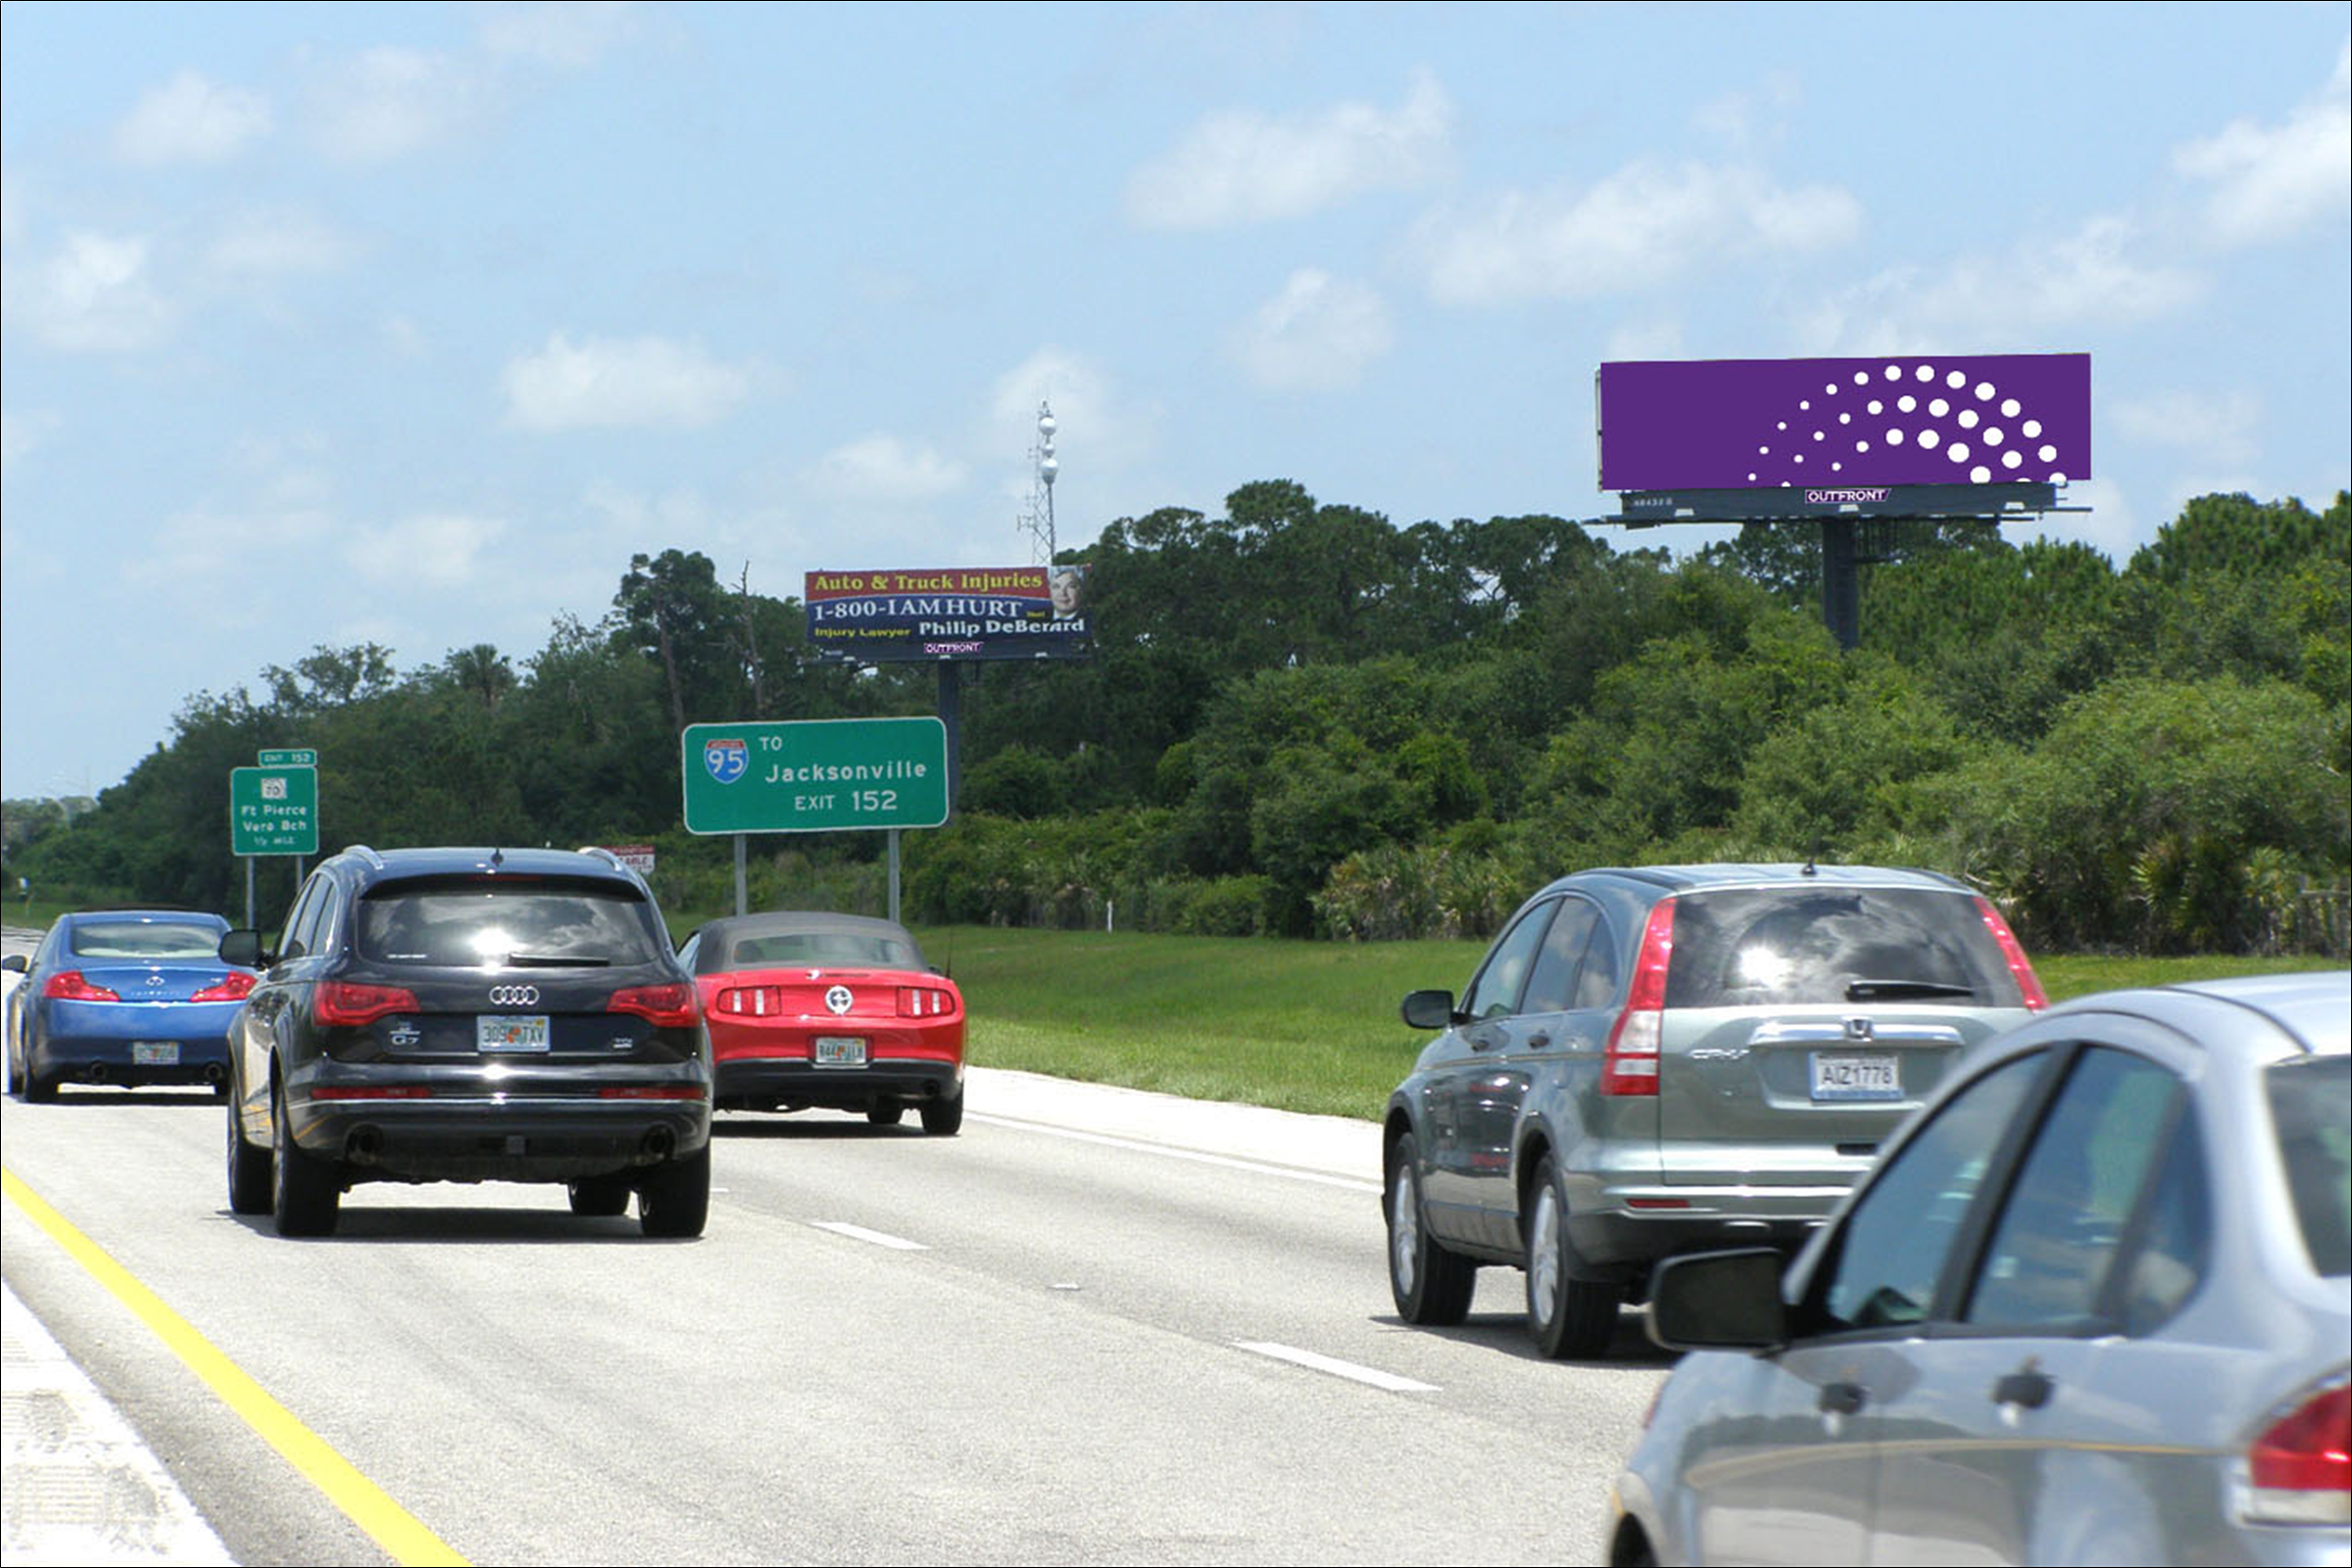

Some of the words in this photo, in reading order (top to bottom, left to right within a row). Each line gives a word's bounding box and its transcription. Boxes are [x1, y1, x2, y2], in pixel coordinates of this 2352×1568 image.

[1807, 490, 1886, 503] OUTFRONT
[815, 575, 863, 590] Auto
[871, 575, 888, 590] &
[896, 574, 954, 590] Truck
[961, 572, 1043, 592] Injuries
[814, 628, 856, 637] Injury
[859, 627, 911, 637] Lawyer
[919, 621, 980, 637] Philip
[985, 619, 1084, 633] DeBerard
[926, 643, 981, 654] OUTFRONT
[759, 736, 782, 751] TO
[291, 754, 311, 762] 152
[709, 750, 743, 774] 95
[765, 761, 927, 783] Jacksonville
[795, 795, 835, 810] EXIT
[852, 790, 898, 811] 152
[241, 806, 257, 816] Ft
[264, 806, 307, 815] Pierce
[243, 821, 274, 832] Vero
[281, 820, 307, 831] Bch
[1822, 1066, 1893, 1085] AIZ1778
